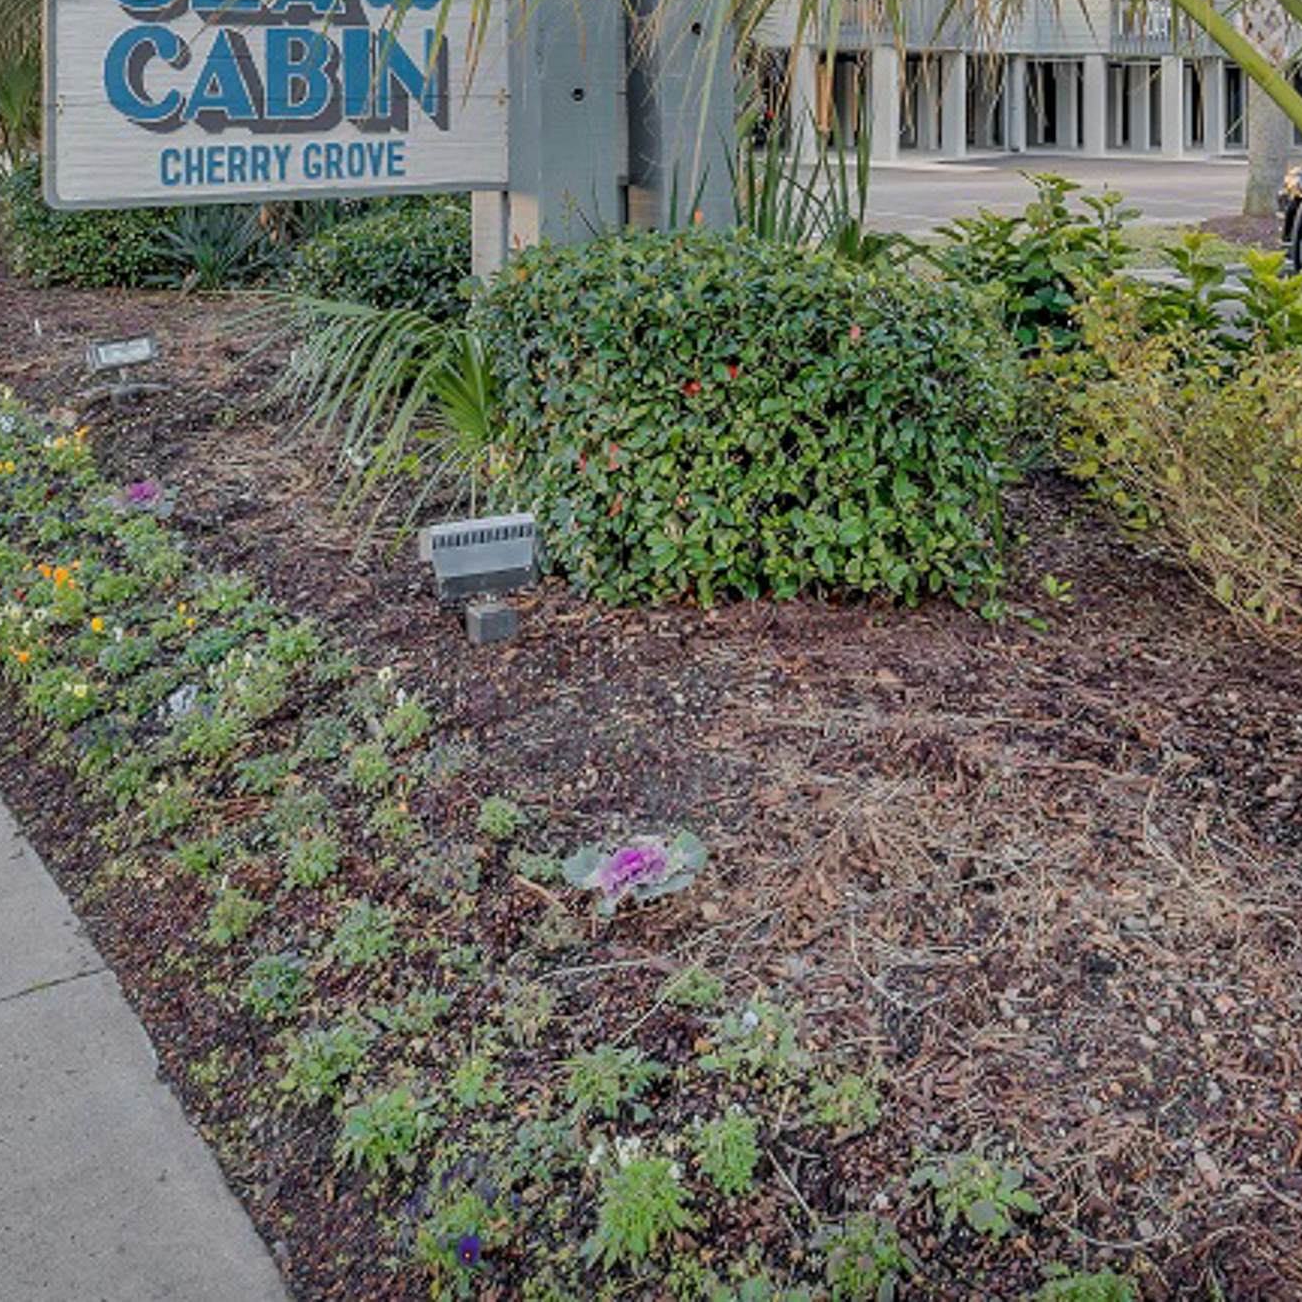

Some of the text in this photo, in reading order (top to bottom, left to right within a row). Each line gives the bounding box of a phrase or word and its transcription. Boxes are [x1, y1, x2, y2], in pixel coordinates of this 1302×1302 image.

[104, 25, 449, 133] CABIN
[160, 140, 407, 186] CHERRY GROVE
